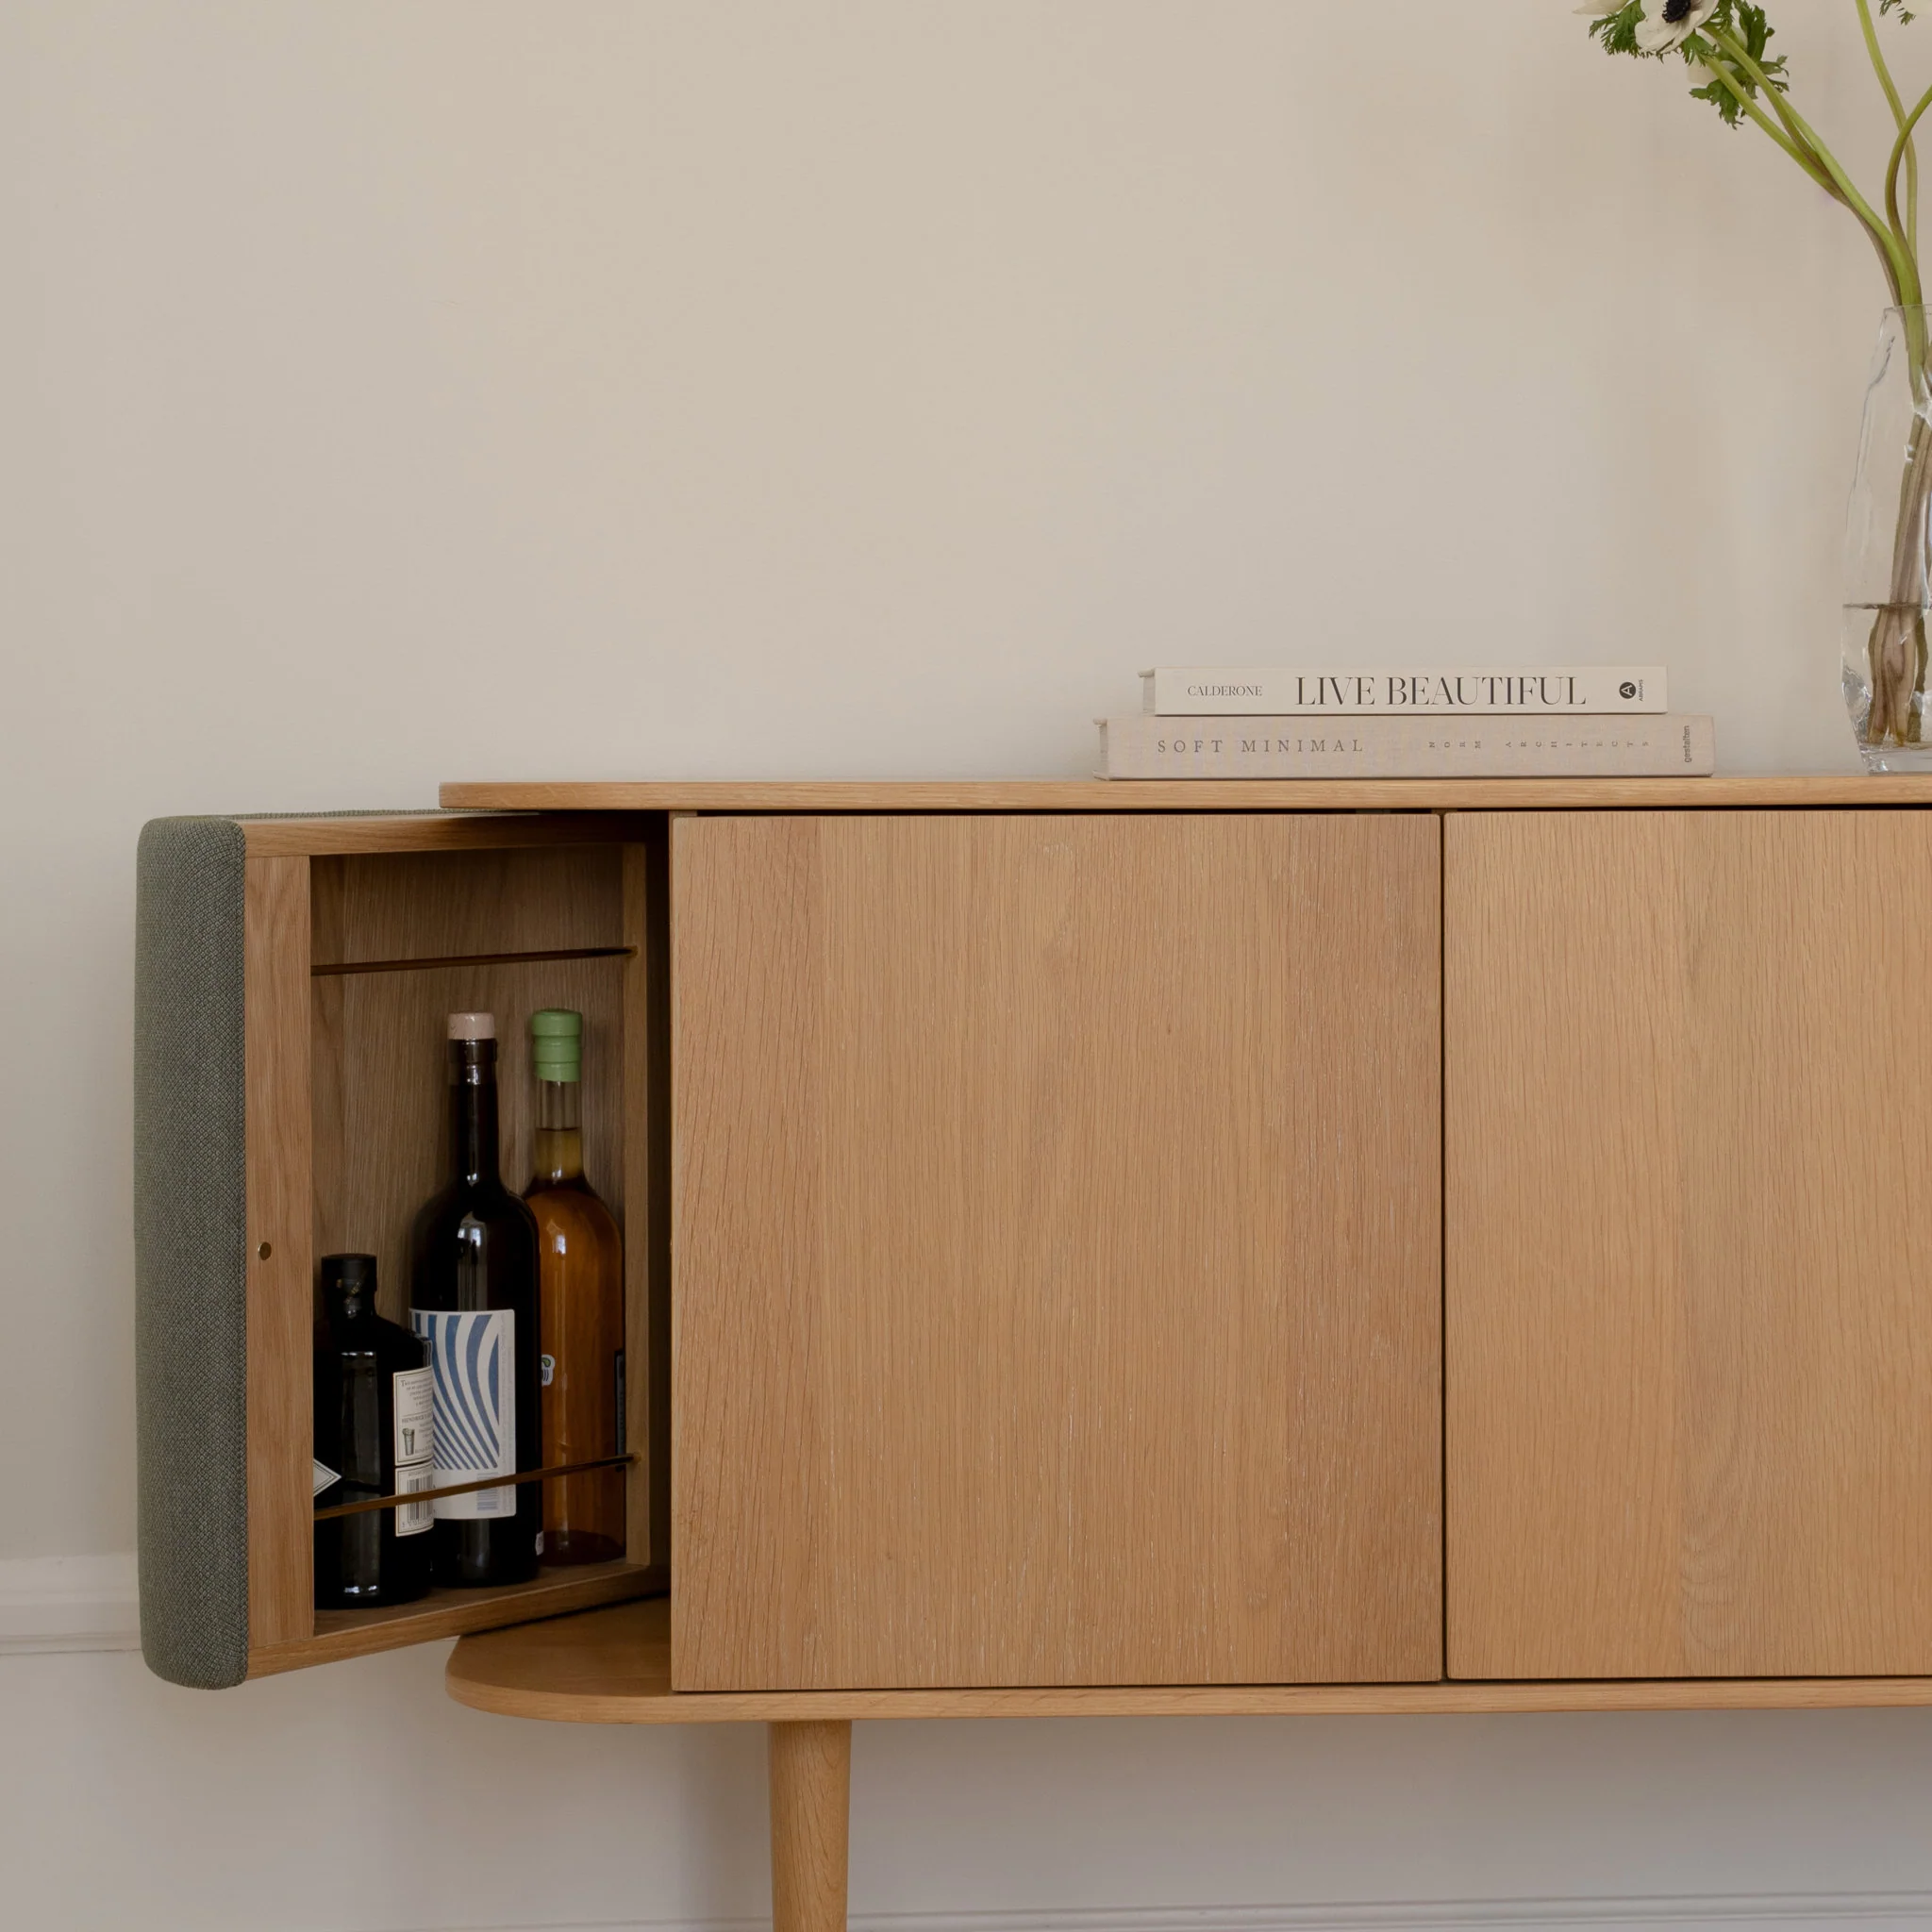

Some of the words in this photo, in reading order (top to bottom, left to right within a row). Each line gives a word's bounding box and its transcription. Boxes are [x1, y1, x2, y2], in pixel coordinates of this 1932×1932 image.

[1187, 685, 1262, 697] CALDERONE
[1295, 676, 1375, 706] LIVE
[1386, 676, 1587, 706] BEAUTIFUL
[1620, 683, 1635, 698] A
[1158, 740, 1224, 753] SOFT
[1241, 739, 1363, 753] MINIMAL
[1428, 740, 1482, 749] NORM
[1505, 740, 1649, 749] ARCHITECTS
[1682, 724, 1692, 763] gestalten
